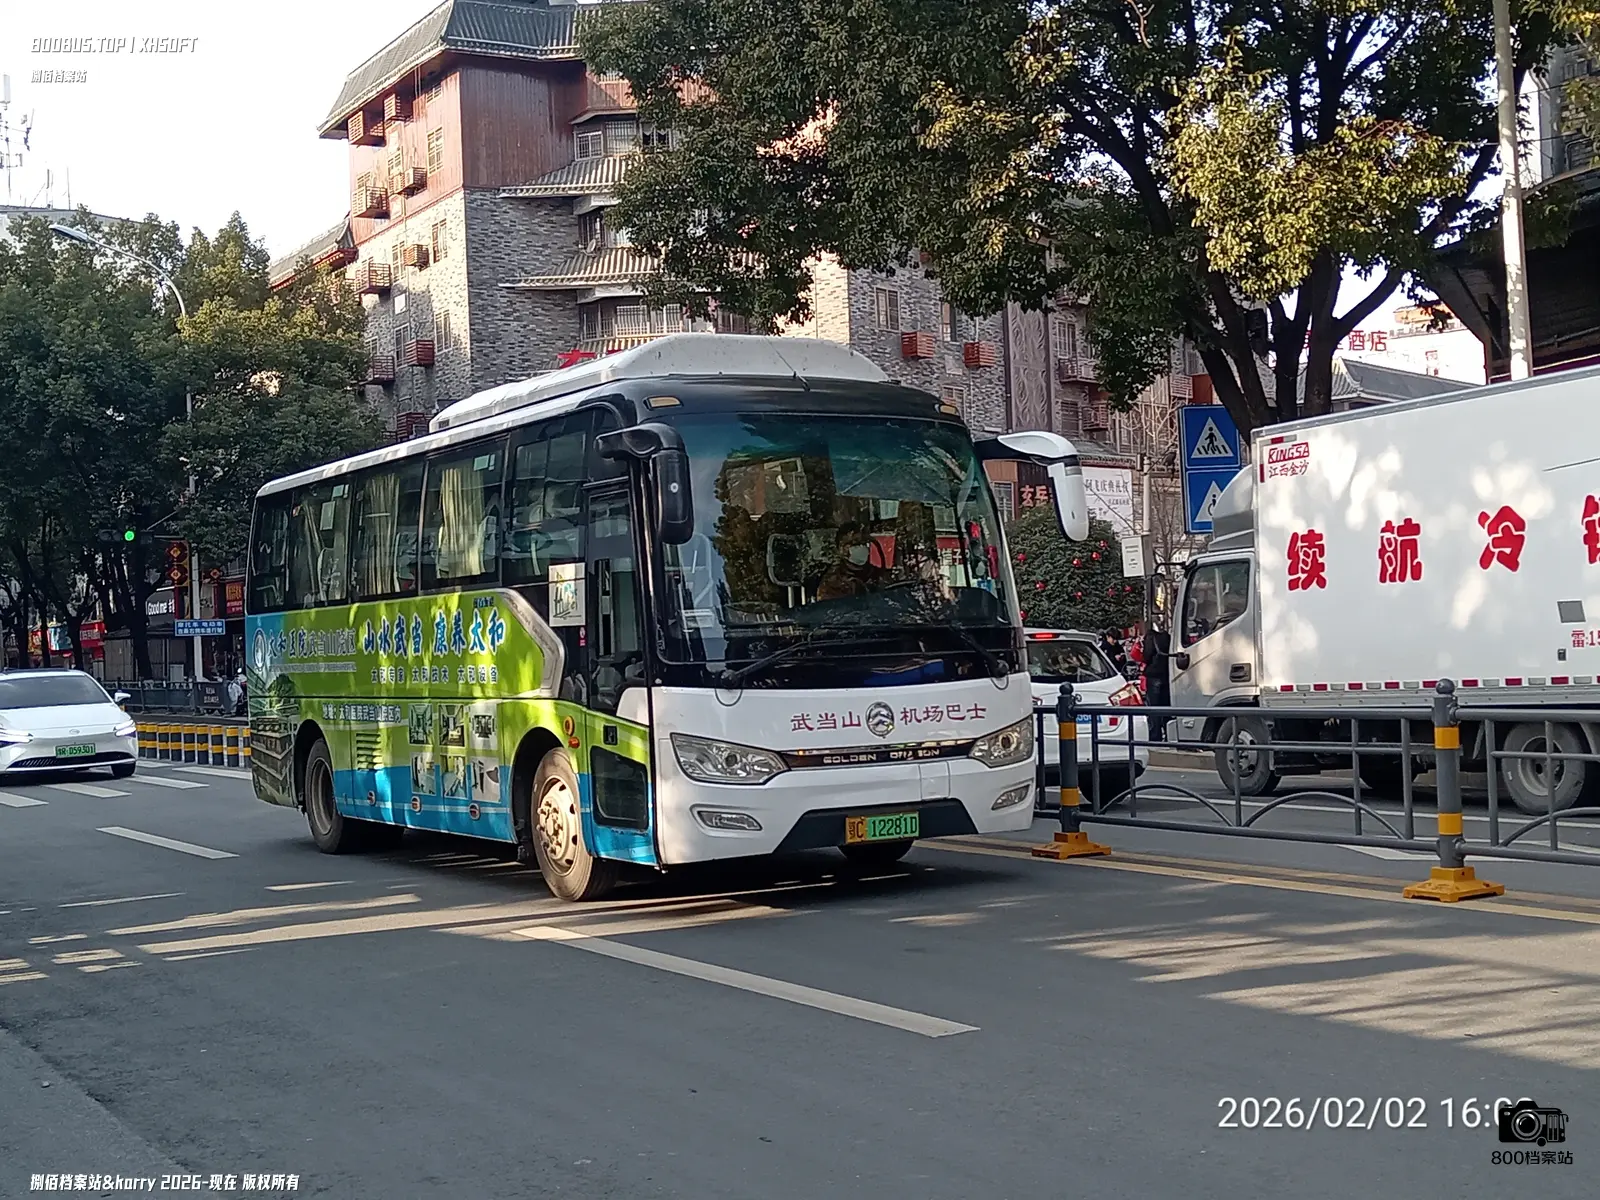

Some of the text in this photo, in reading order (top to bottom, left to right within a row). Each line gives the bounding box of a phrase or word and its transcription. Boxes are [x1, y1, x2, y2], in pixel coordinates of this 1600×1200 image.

[1337, 330, 1388, 352] 酒店
[1268, 460, 1309, 478] 江西金沙
[363, 612, 424, 659] 山水武当
[790, 703, 987, 733] 武当山 机场巴士
[823, 753, 877, 764] GOLDEN
